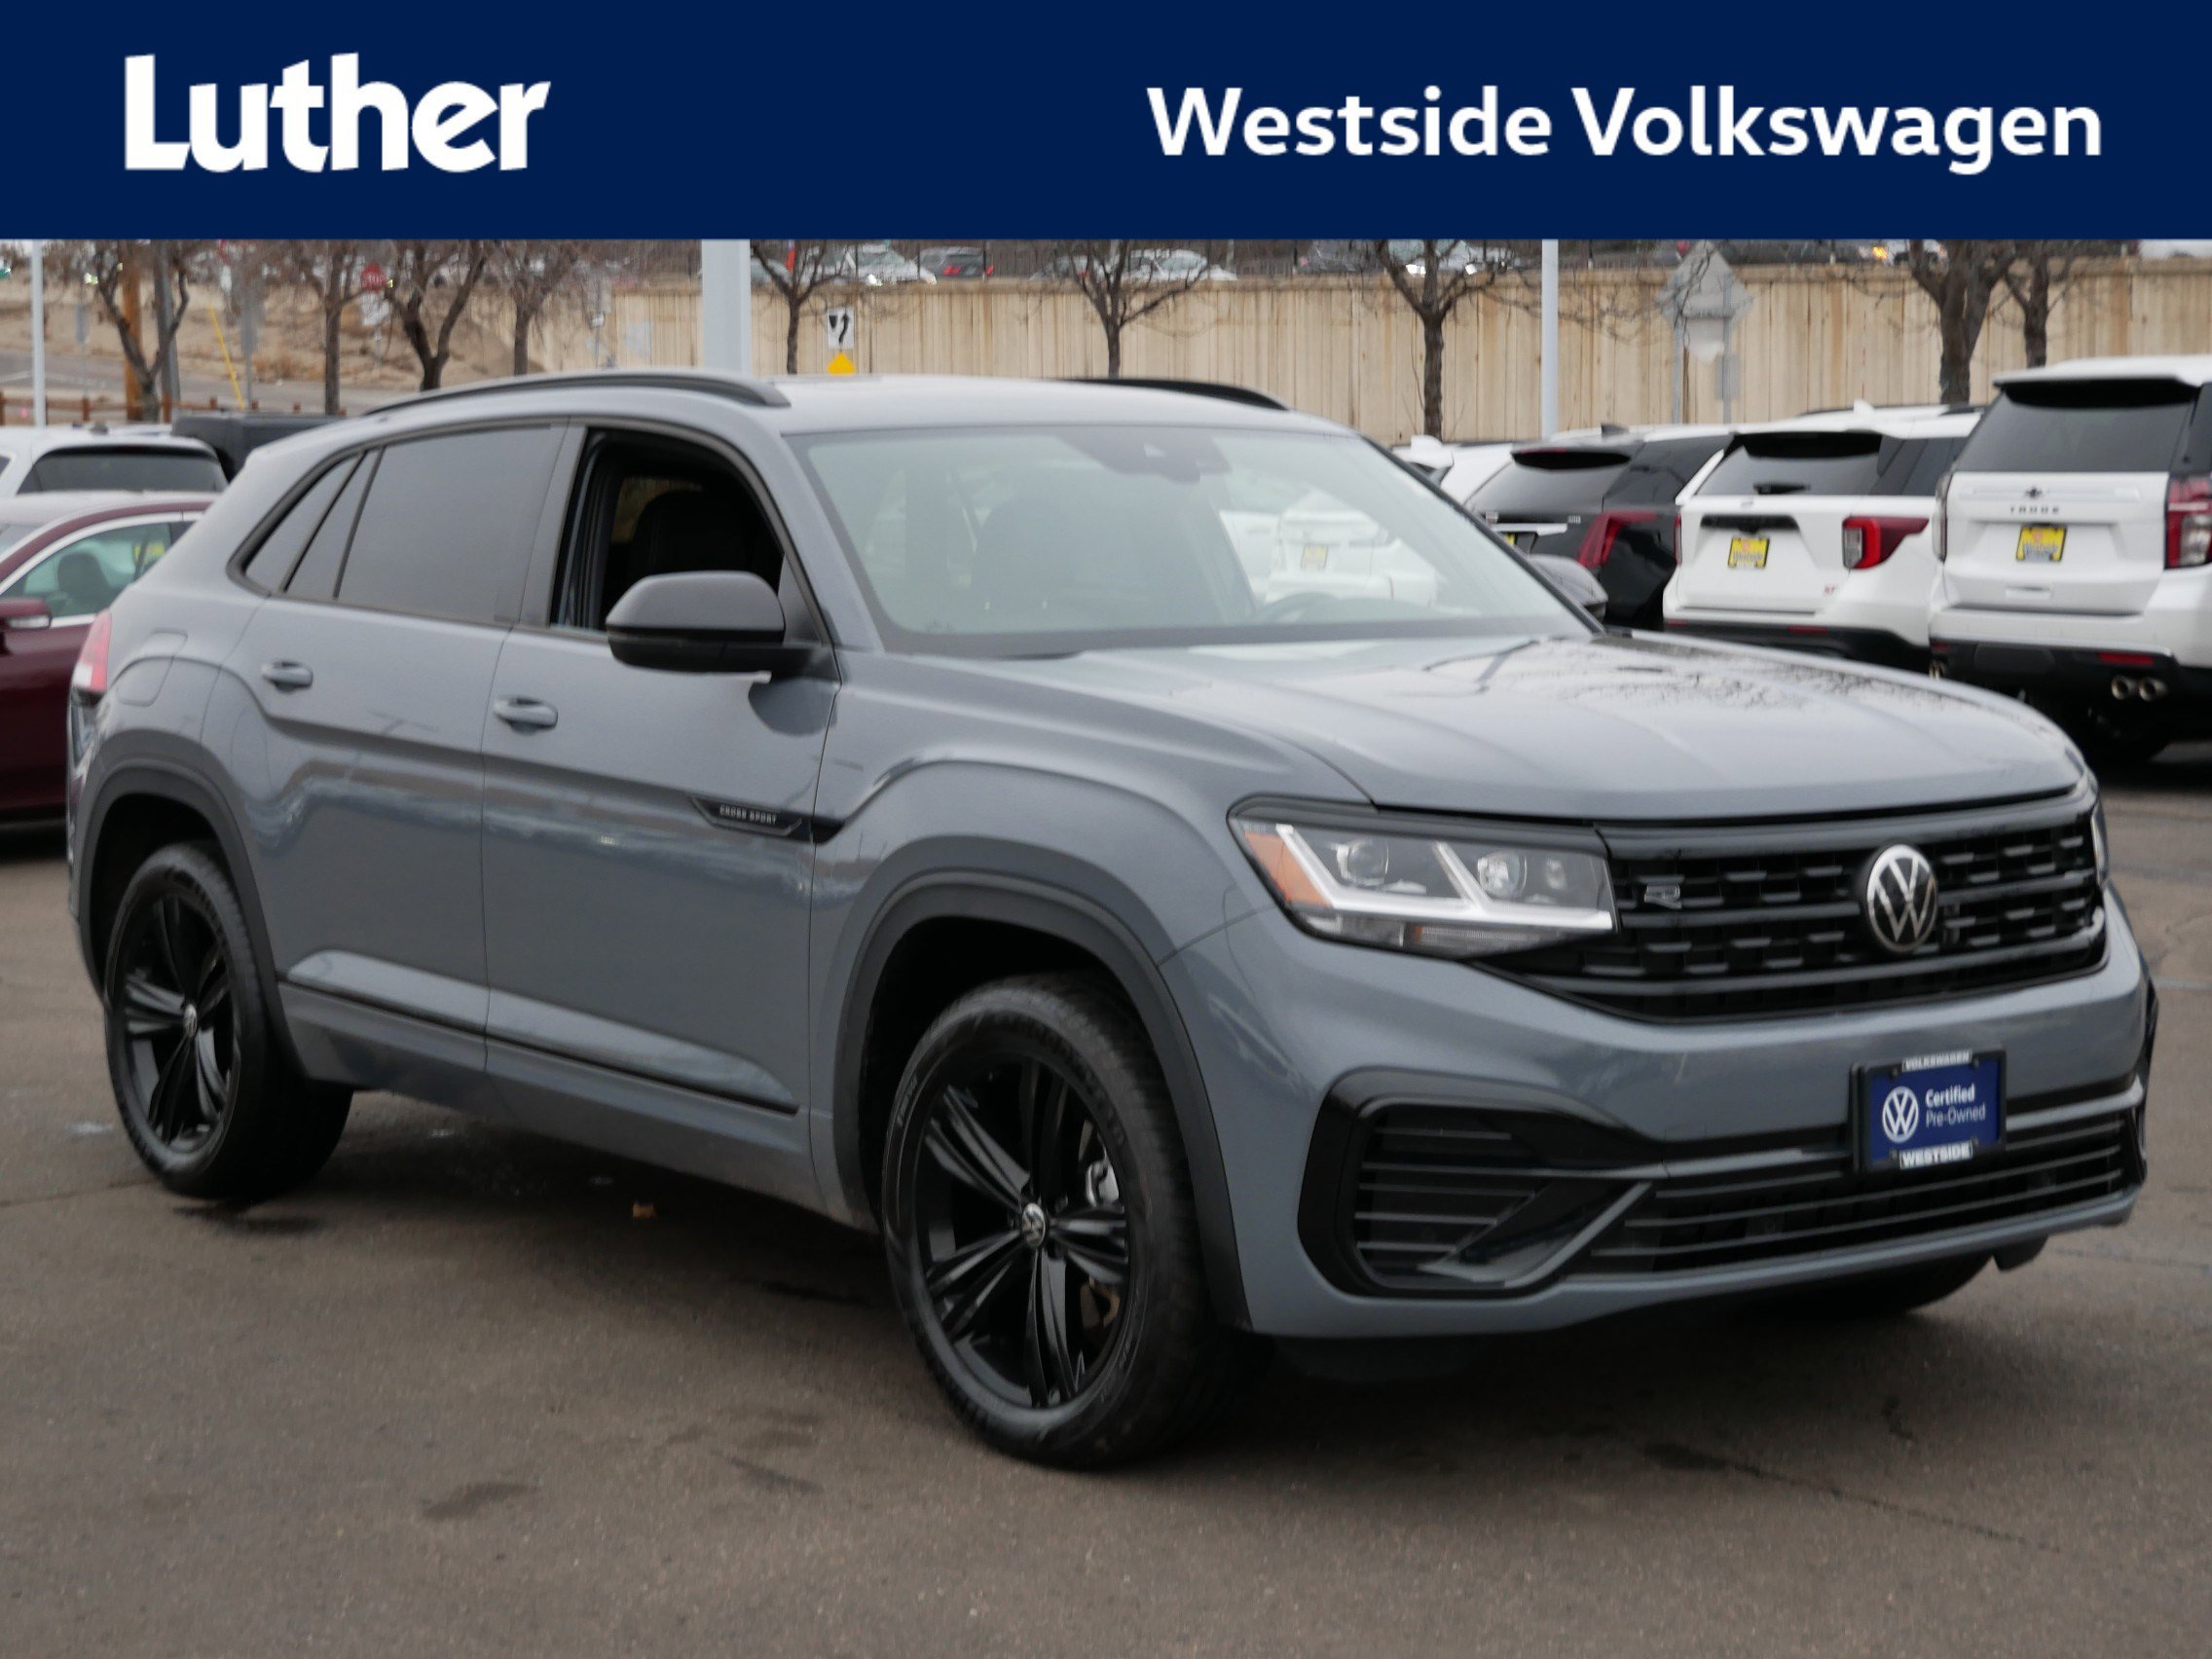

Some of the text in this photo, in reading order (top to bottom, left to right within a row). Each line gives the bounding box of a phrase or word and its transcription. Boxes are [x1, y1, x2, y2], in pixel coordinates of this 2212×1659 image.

[1925, 1084, 1975, 1107] Certified
[1883, 1087, 1919, 1143] VW
[1926, 1103, 1986, 1127] Pre-Owned
